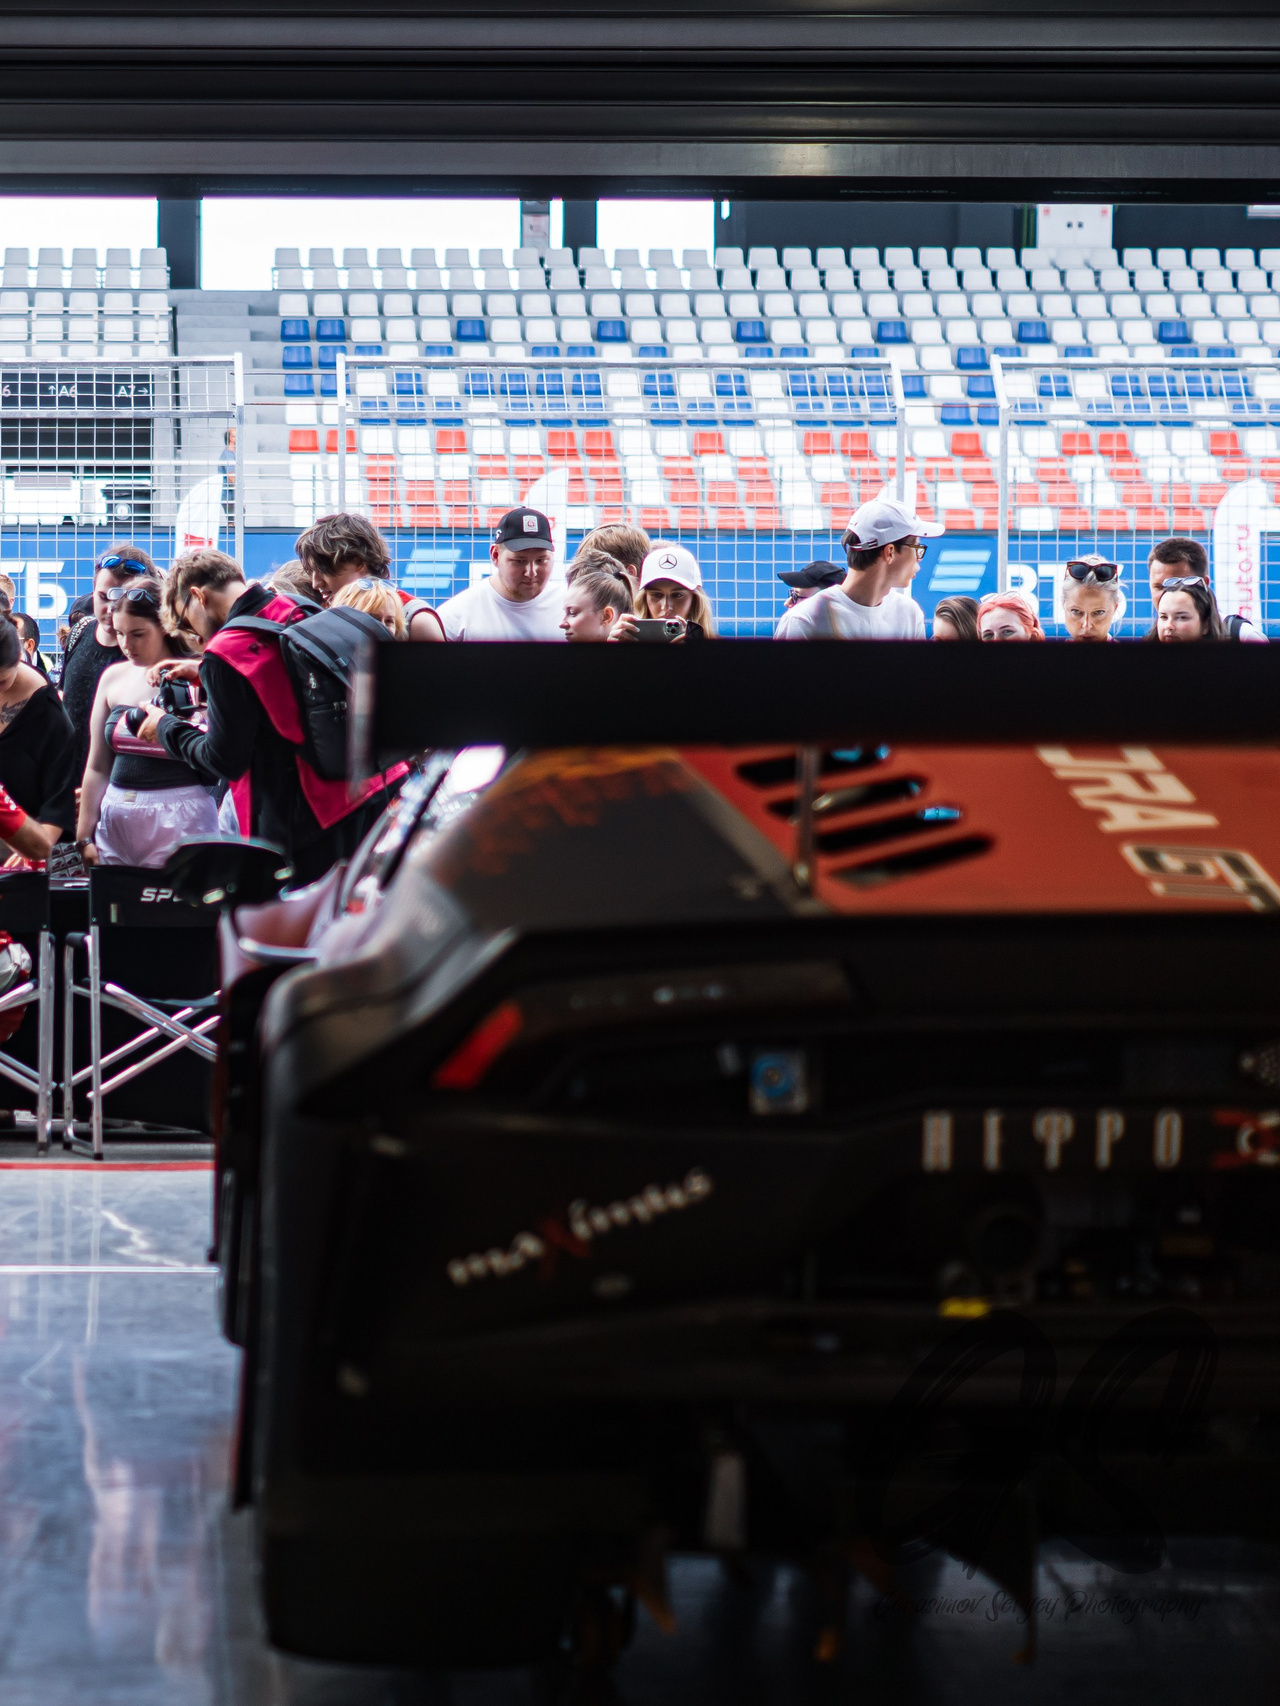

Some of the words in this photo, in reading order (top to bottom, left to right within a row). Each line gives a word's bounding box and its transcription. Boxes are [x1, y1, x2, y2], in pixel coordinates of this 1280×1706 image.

[59, 384, 77, 398] A6
[117, 385, 136, 398] A7
[140, 886, 183, 903] SP
